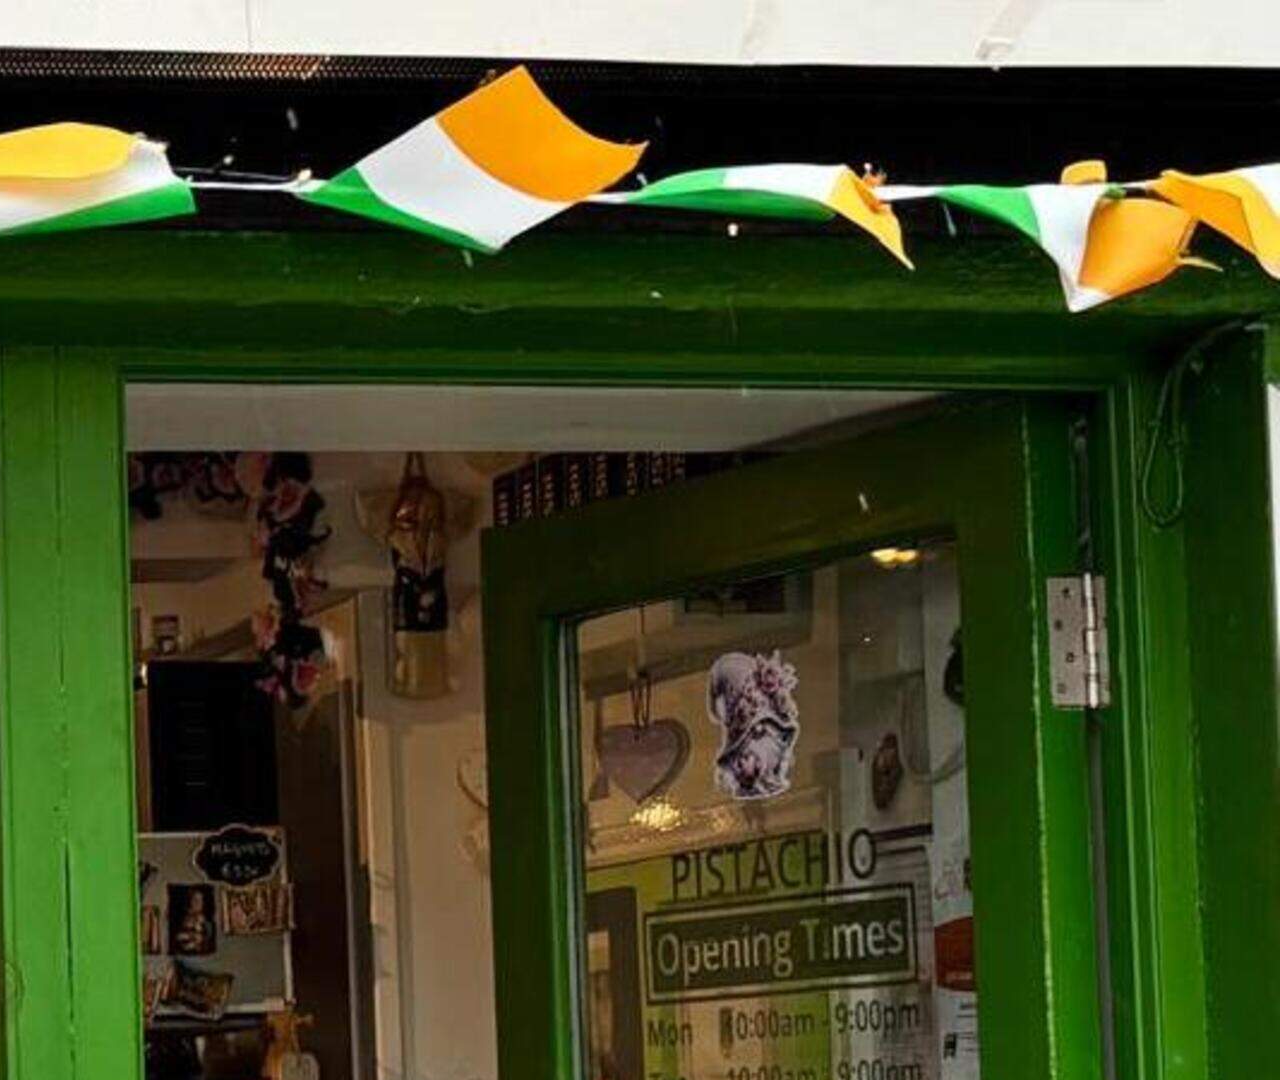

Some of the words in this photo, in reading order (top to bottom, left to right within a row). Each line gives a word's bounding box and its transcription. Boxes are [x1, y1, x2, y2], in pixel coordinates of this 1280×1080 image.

[670, 827, 878, 900] PISTACHIO
[656, 924, 795, 986] Opening
[798, 916, 906, 963] Times
[647, 1019, 693, 1047] Mon
[834, 999, 920, 1040] 9:00pm
